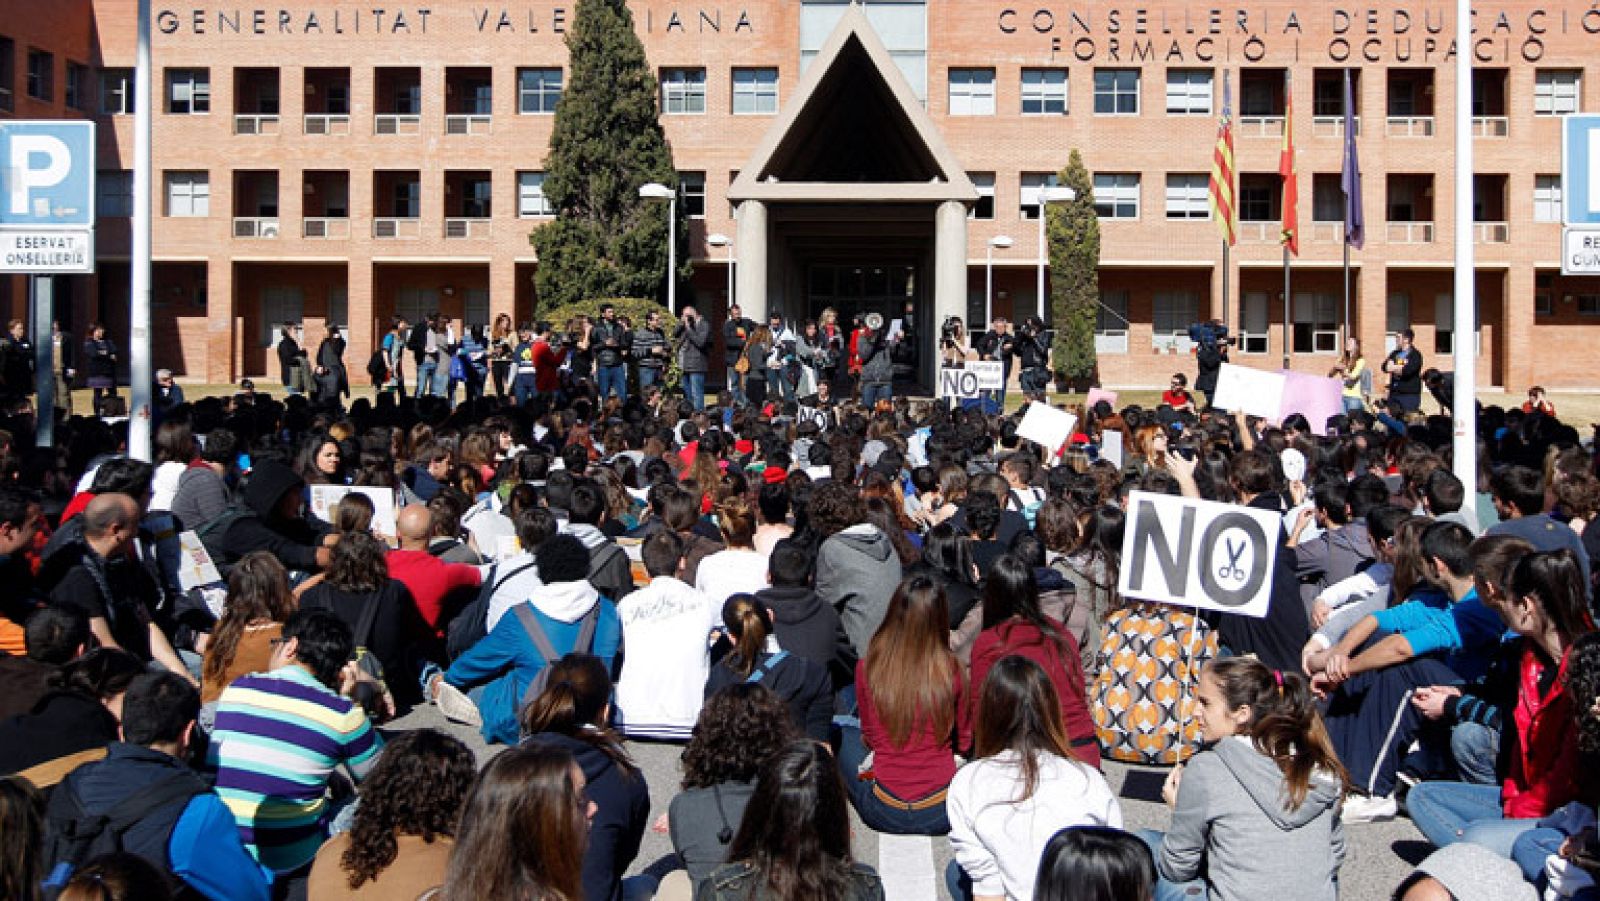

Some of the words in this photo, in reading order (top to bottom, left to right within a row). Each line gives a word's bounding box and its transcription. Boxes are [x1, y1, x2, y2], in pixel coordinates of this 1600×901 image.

[157, 9, 432, 34] GENERALITAT
[473, 8, 753, 33] VALEIANA
[999, 9, 1302, 34] CONSELLERIA
[1051, 34, 1266, 62] FORMACIÓ
[1294, 38, 1299, 62] I
[1328, 36, 1545, 62] OCUPACIÓ
[10, 135, 71, 213] P
[943, 370, 978, 396] NO
[1128, 500, 1268, 607] NO
